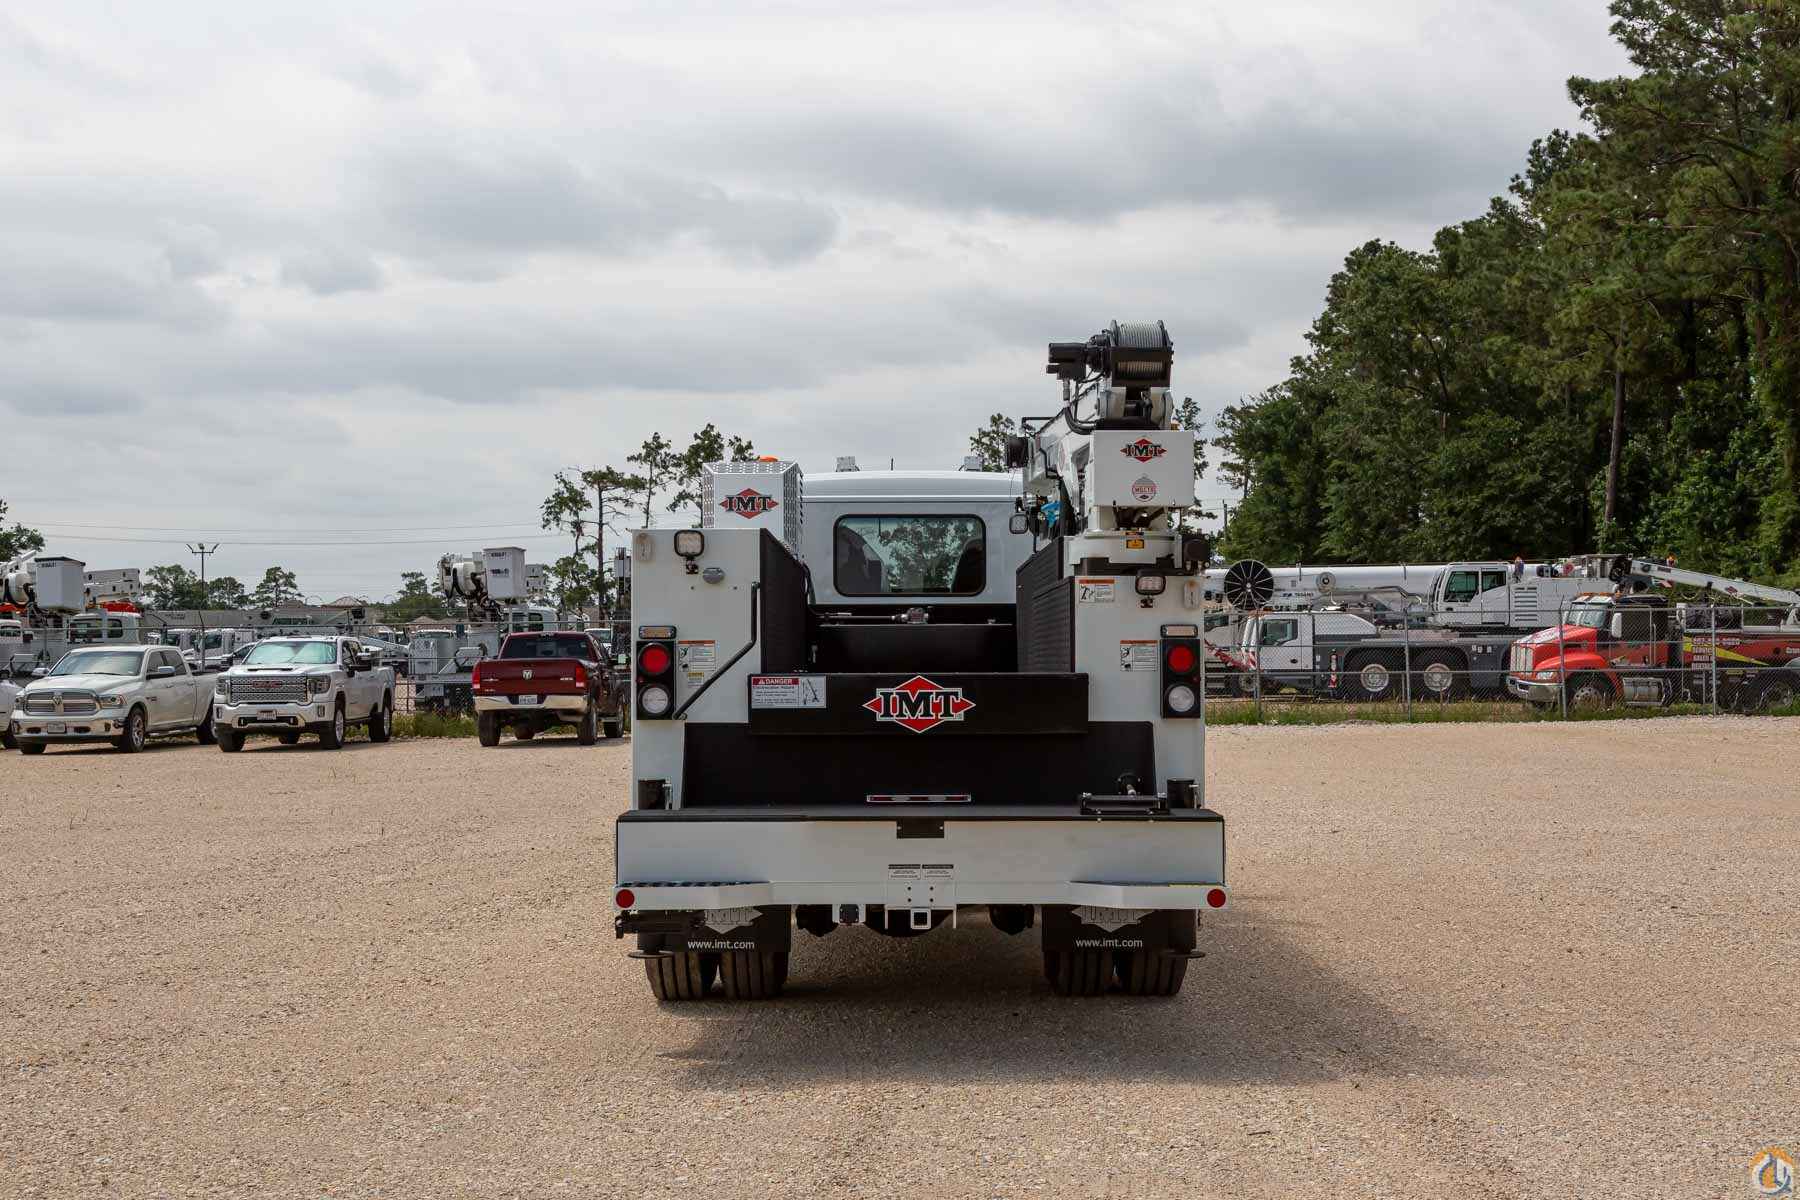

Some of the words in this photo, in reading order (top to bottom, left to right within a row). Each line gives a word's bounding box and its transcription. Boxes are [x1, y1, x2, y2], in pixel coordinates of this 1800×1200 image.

[1125, 443, 1162, 457] IMT
[725, 494, 772, 512] IMT
[876, 688, 964, 721] IMT
[687, 939, 755, 949] www.imt.com
[1075, 938, 1143, 948] www.imt.com
